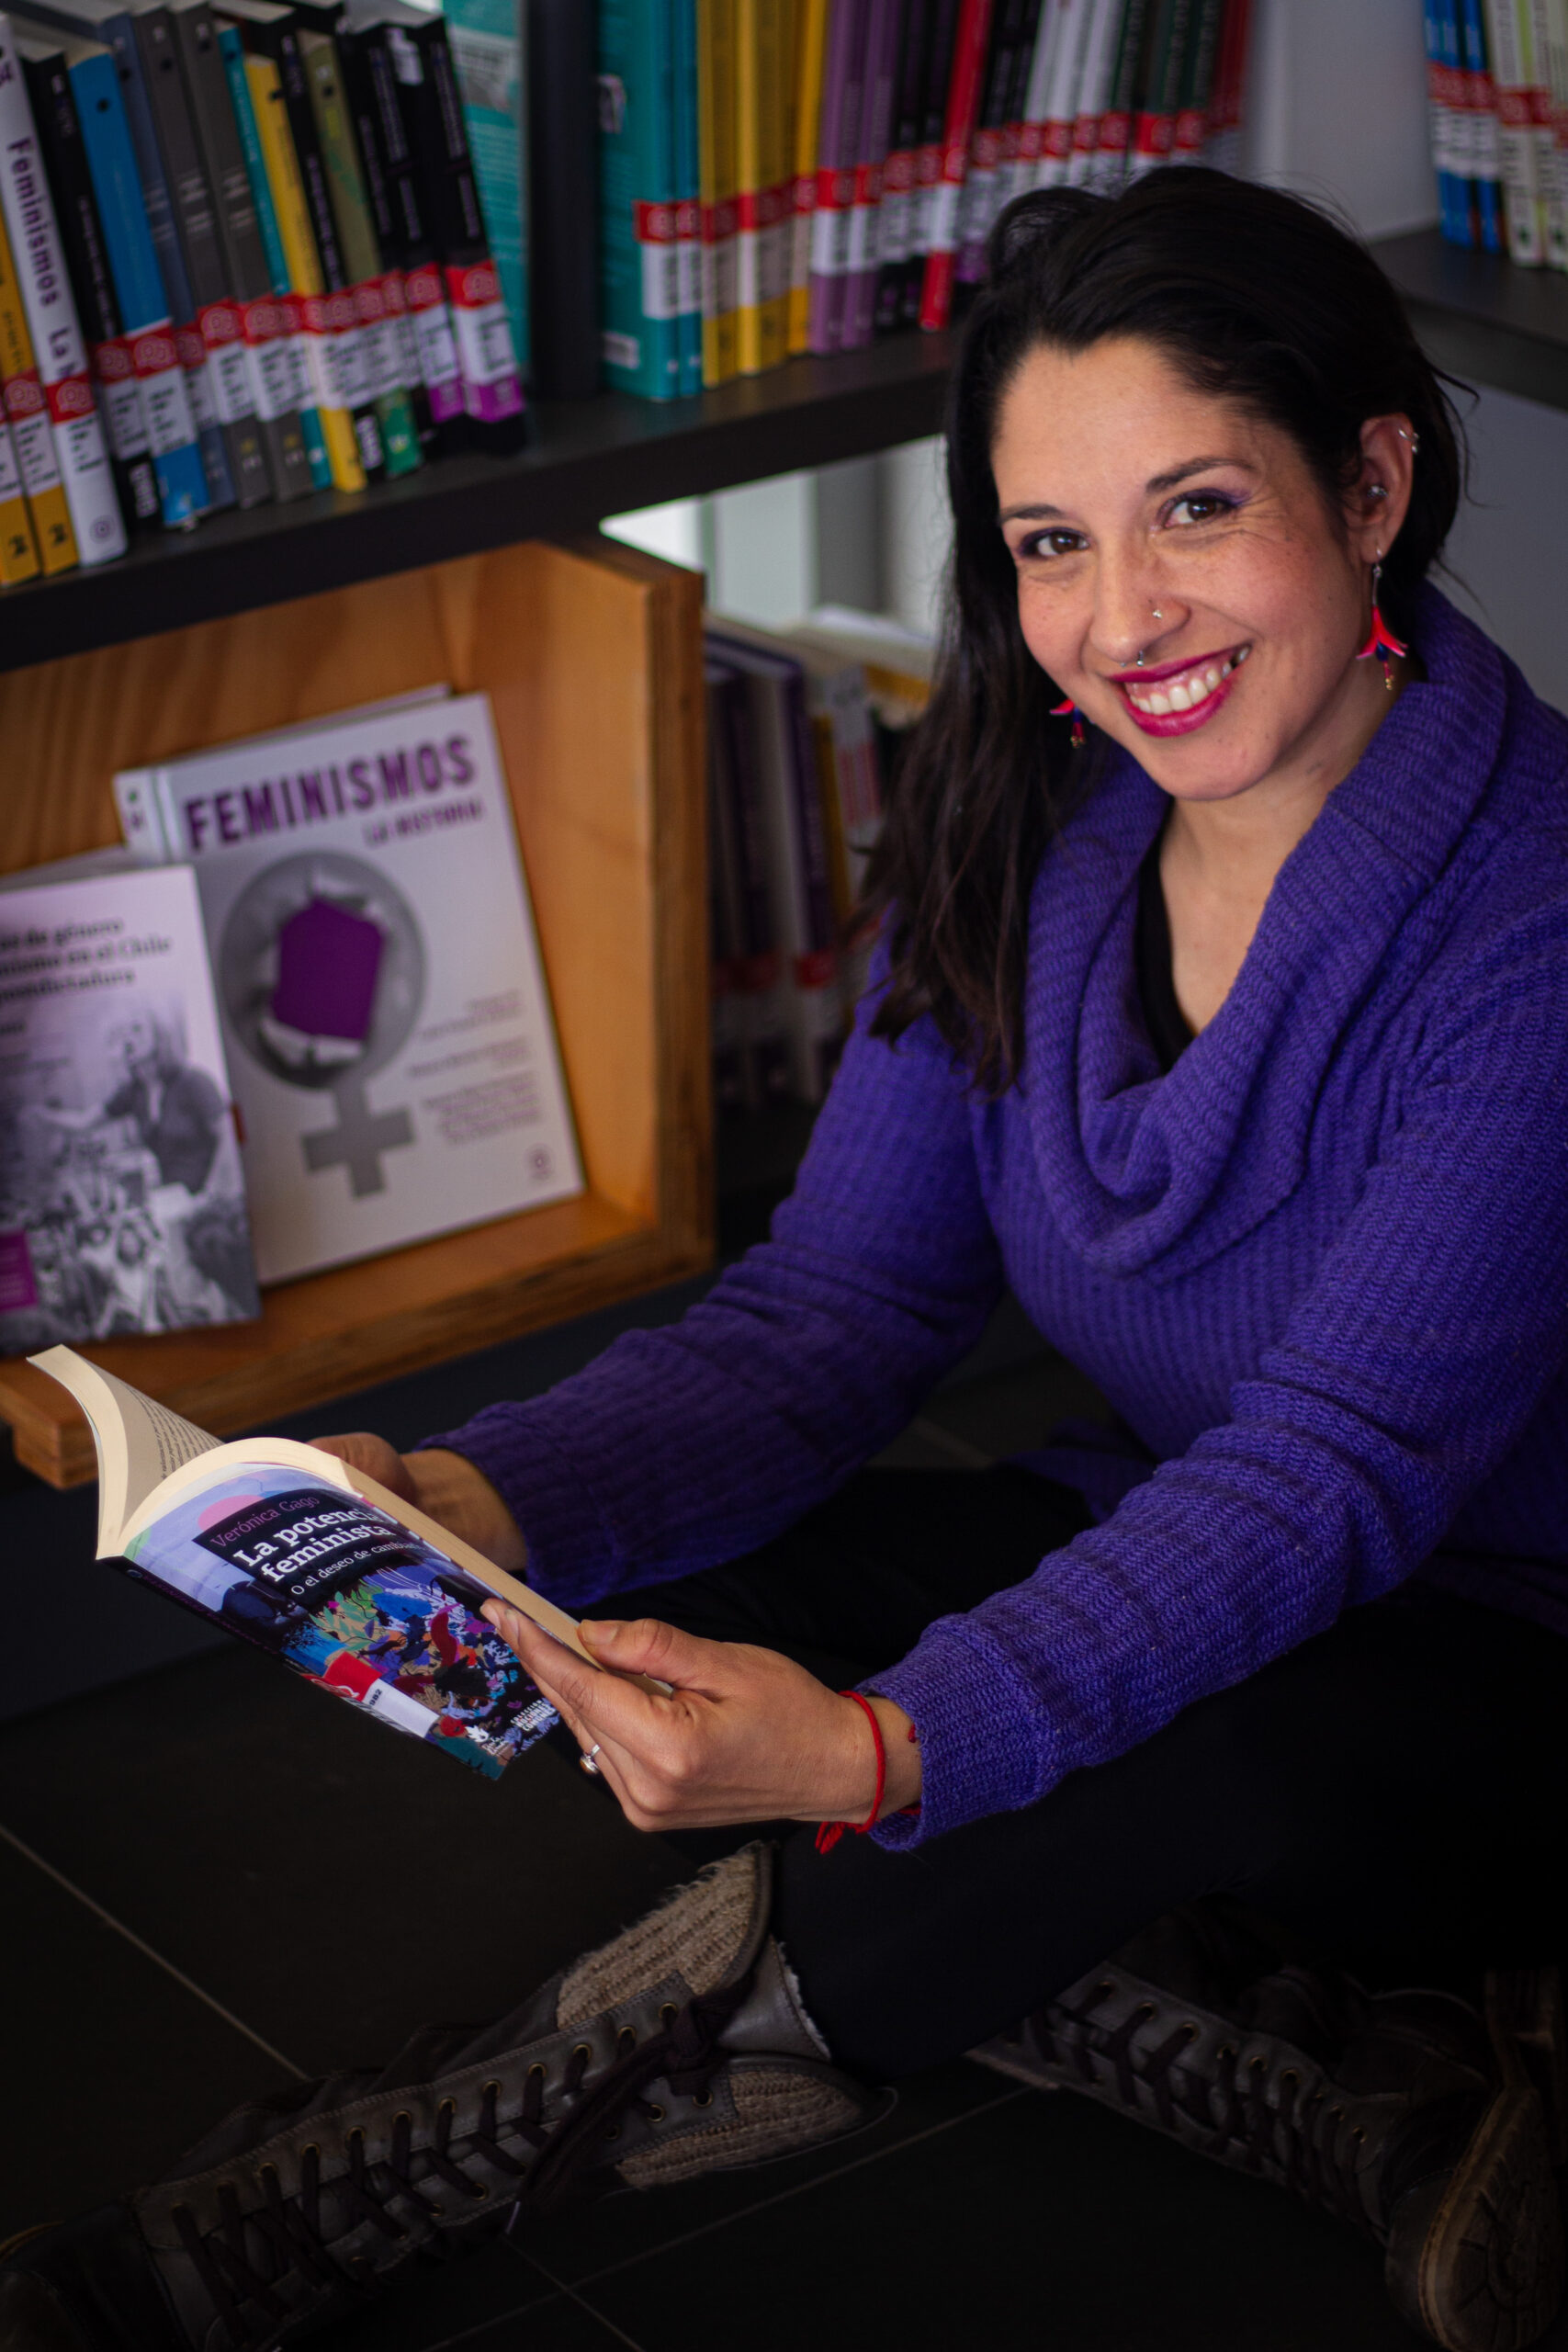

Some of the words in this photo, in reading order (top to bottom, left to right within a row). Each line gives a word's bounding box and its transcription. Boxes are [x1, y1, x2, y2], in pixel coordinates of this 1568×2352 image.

[6, 138, 62, 308] Feminismos
[50, 327, 70, 359] La
[184, 736, 475, 853] FEMINISMOS
[118, 933, 172, 958] Chile
[210, 1507, 280, 1548] Verónica
[279, 1496, 321, 1512] Gago
[233, 1541, 279, 1566] La
[261, 1523, 397, 1582] feminista
[290, 1585, 305, 1596] O
[305, 1575, 321, 1588] el
[318, 1556, 355, 1579] deseo
[354, 1544, 372, 1560] de
